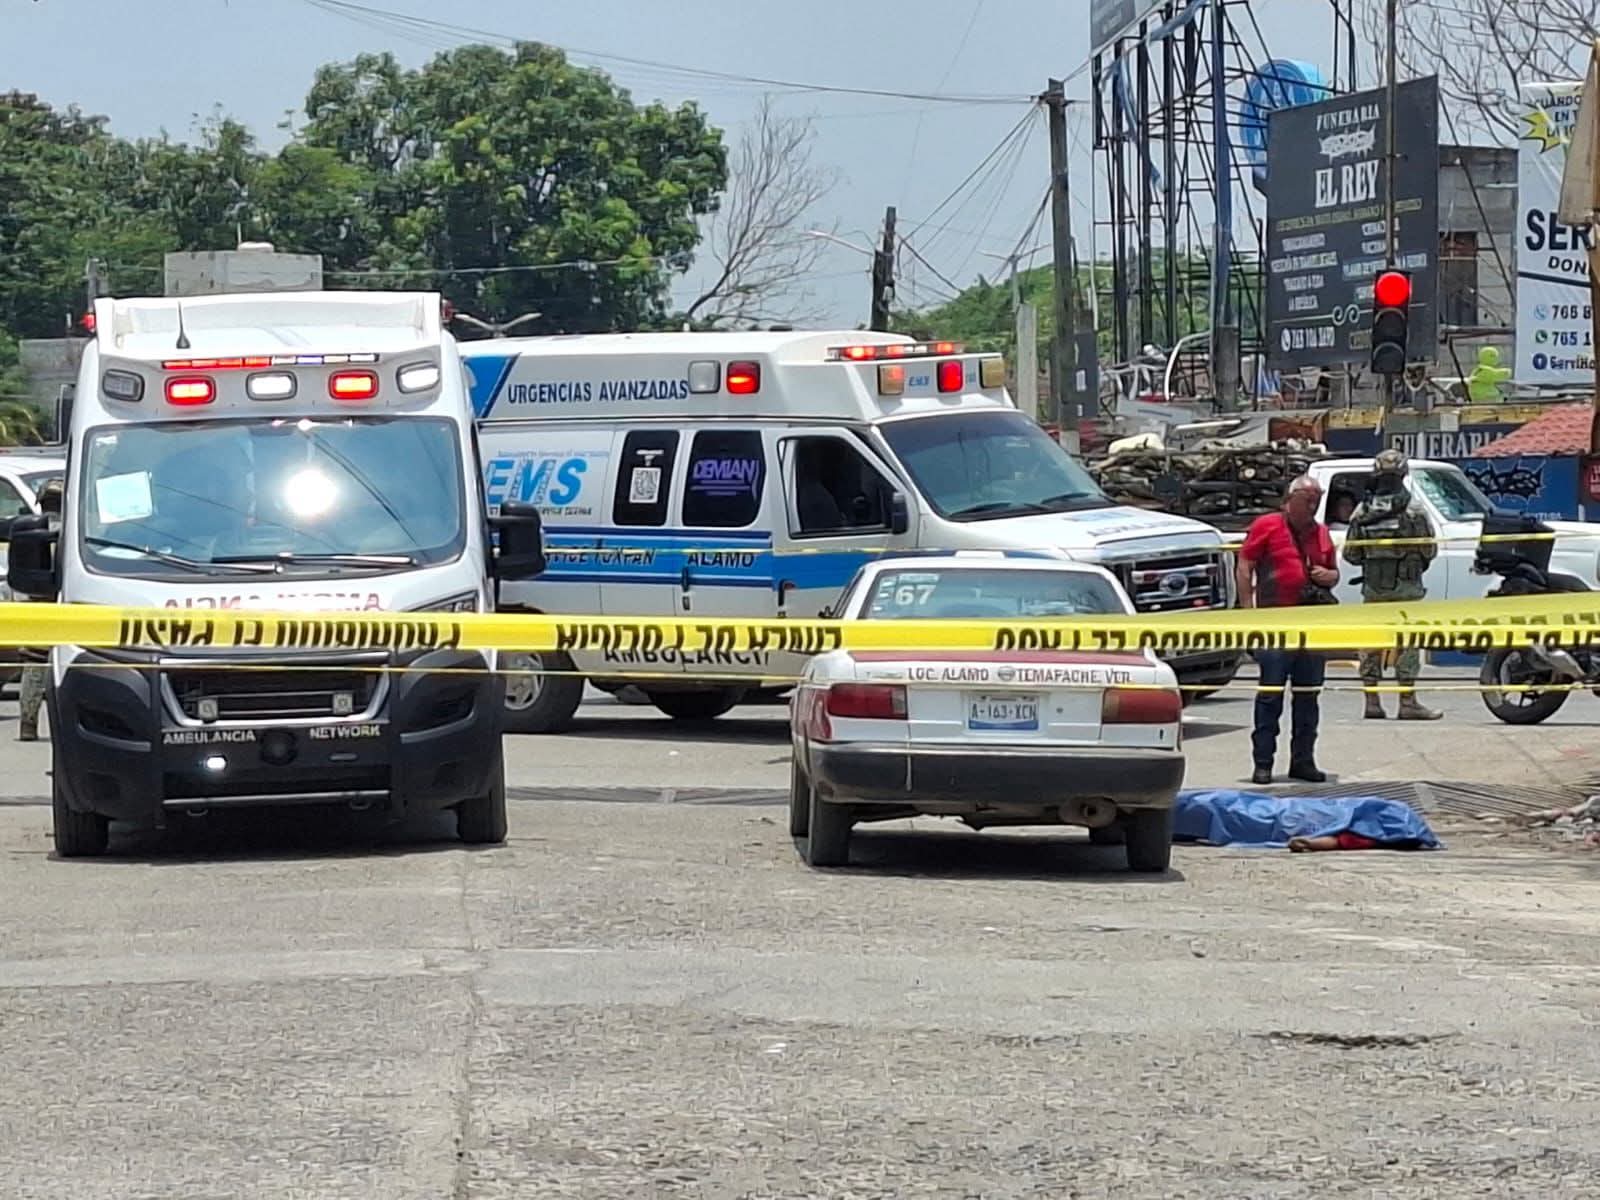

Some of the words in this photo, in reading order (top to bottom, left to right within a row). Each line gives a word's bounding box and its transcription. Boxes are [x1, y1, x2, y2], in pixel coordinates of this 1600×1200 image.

[1316, 103, 1381, 132] FUNERARIA
[1314, 167, 1338, 208] EL
[1340, 159, 1380, 204] REY
[507, 381, 592, 405] URGENCIAS
[598, 379, 689, 402] AVANZADAS
[486, 458, 588, 506] EMS
[895, 584, 937, 606] 67
[942, 667, 989, 681] ALAMO
[163, 729, 257, 745] AMBULANCIA
[309, 724, 381, 740] NETWORK
